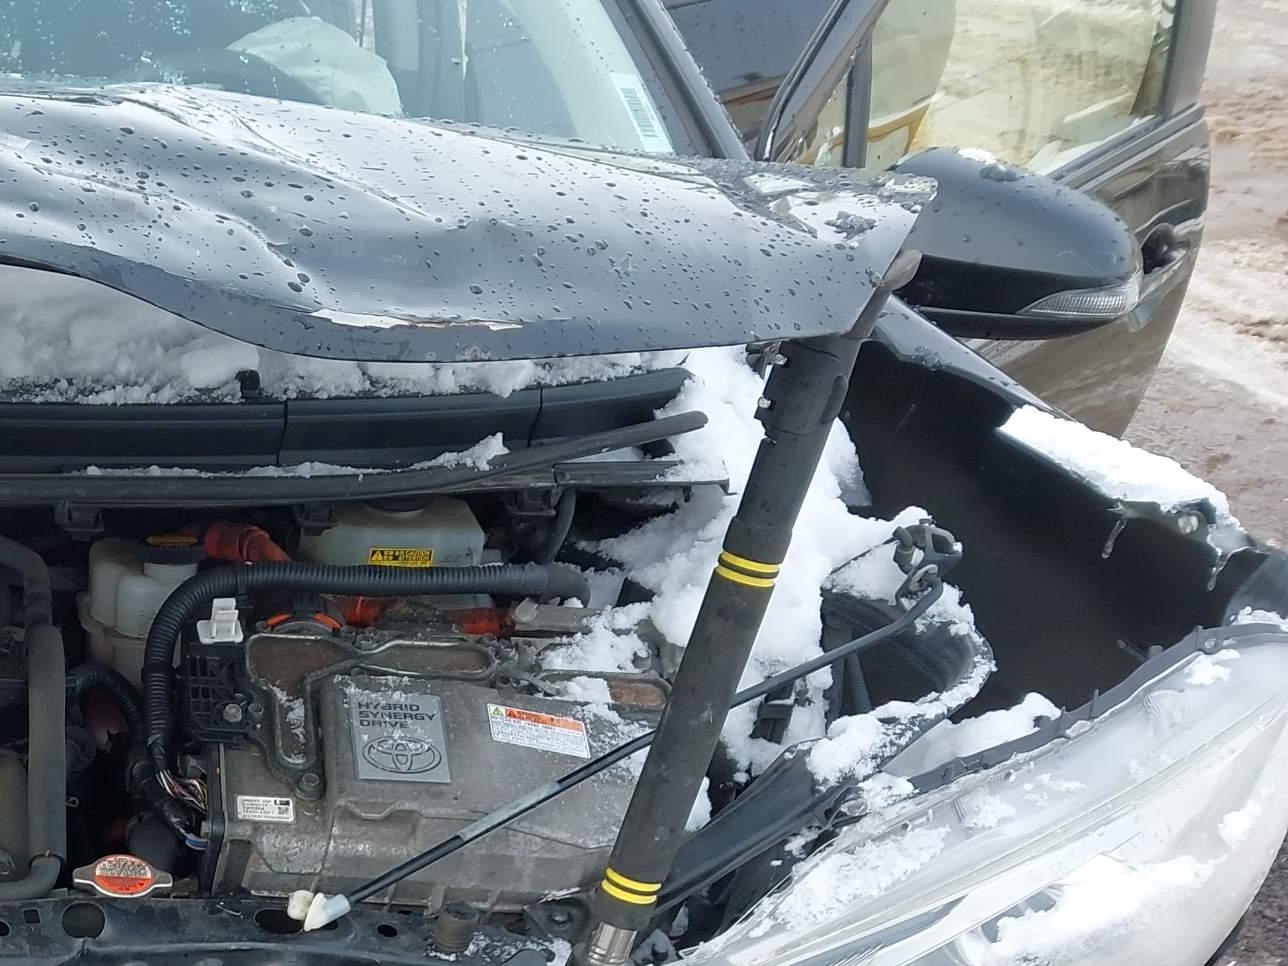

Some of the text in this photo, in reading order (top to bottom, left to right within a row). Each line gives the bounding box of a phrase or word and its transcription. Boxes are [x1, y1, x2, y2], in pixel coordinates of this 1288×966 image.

[358, 702, 420, 711] HYBRID
[359, 710, 436, 721] SYNERGY
[359, 719, 409, 728] DRIVE
